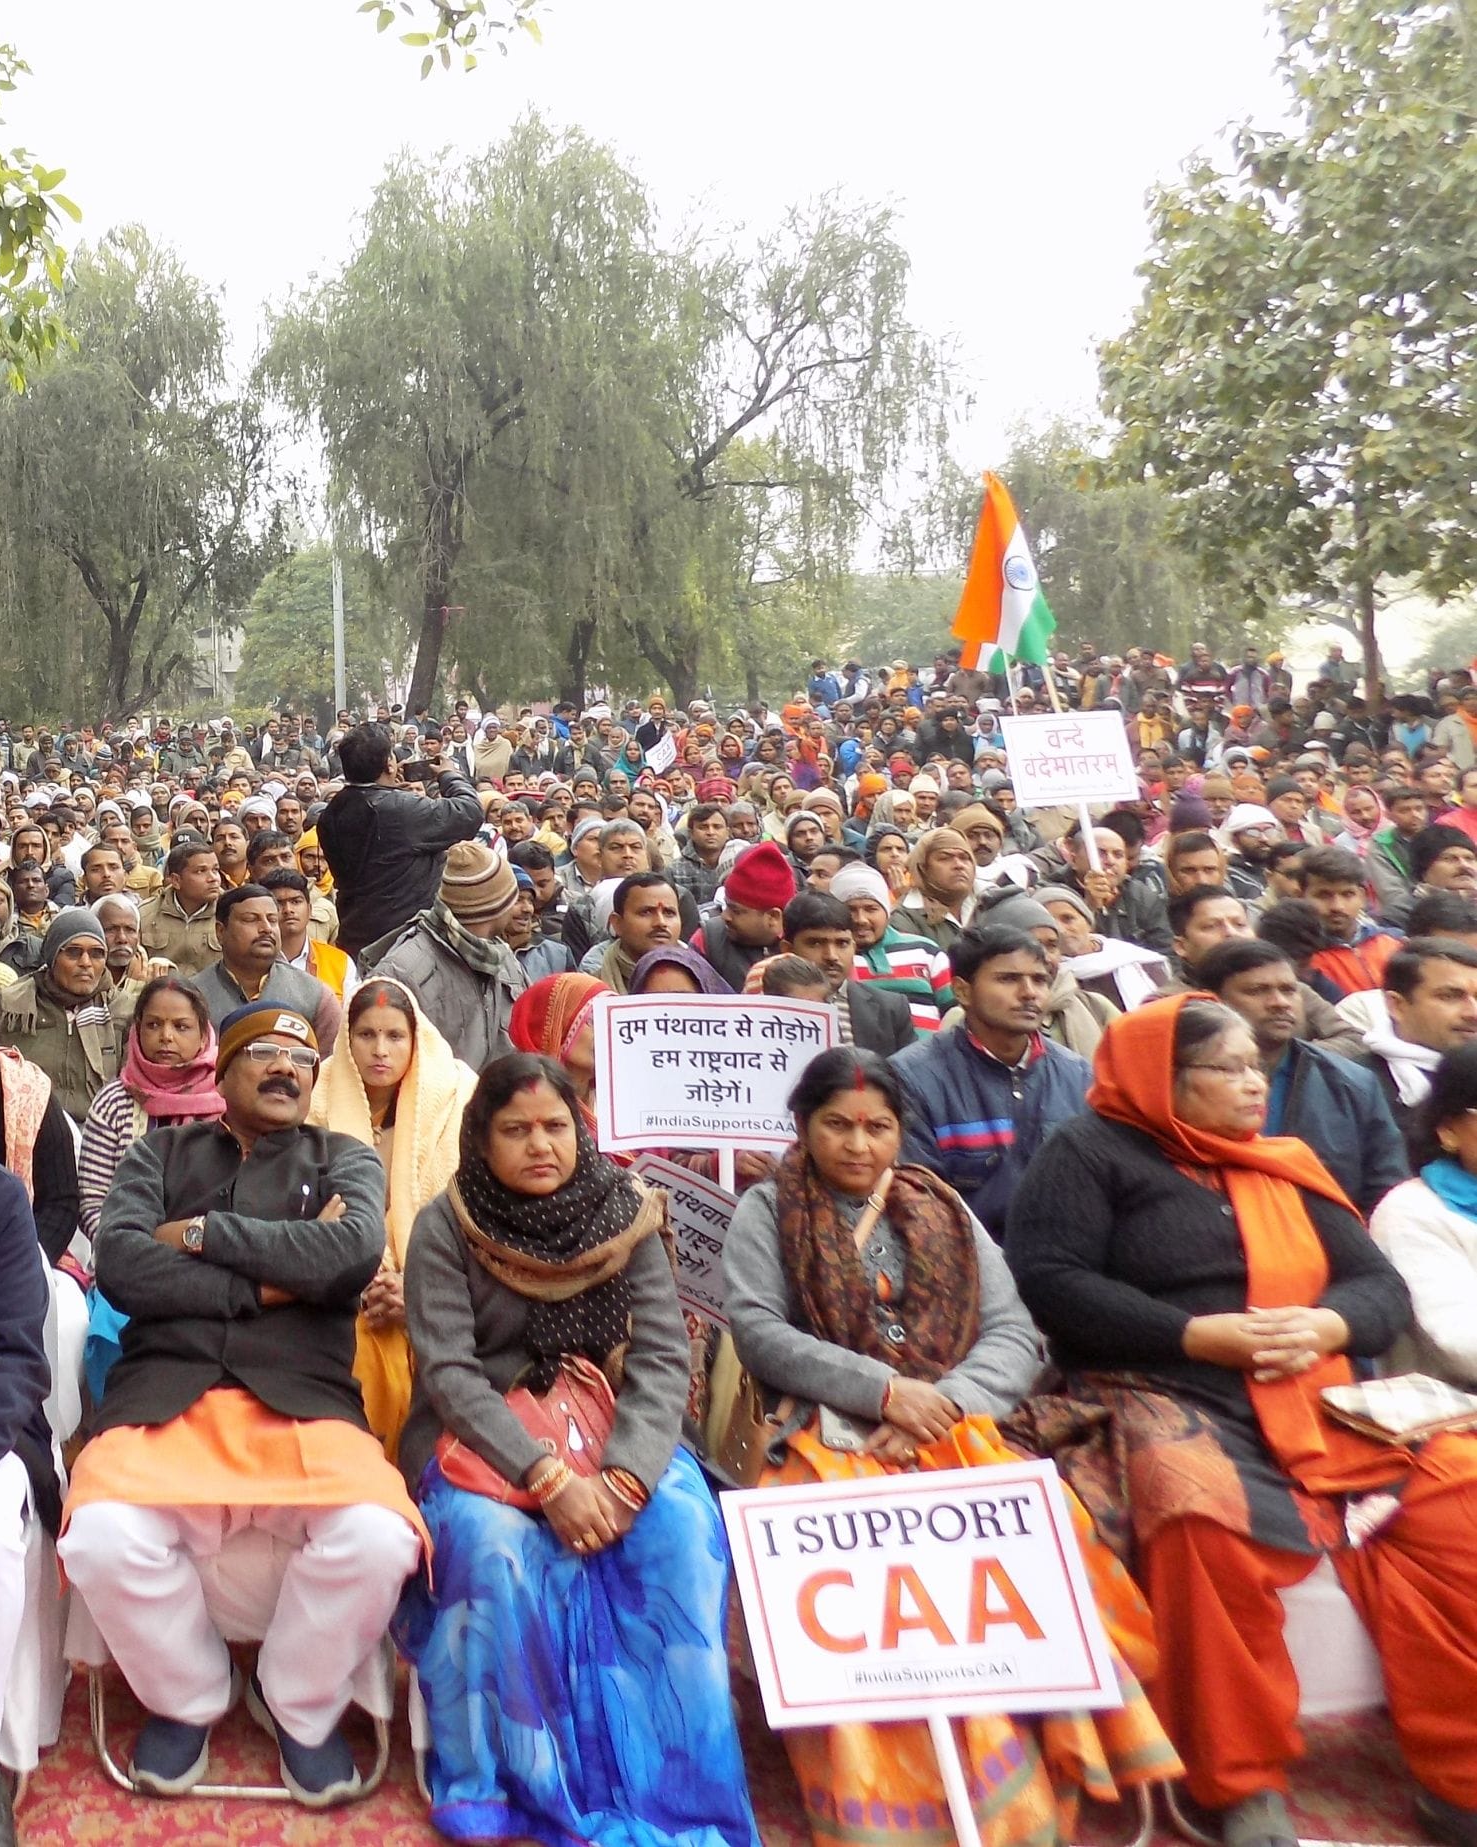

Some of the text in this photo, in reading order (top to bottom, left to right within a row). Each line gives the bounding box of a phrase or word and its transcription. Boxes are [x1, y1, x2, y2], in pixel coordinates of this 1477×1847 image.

[1045, 722, 1085, 749] वन्दे
[1021, 751, 1123, 780] वंदेमातरम्
[617, 1013, 822, 1046] तुम पंथवाद से तोड़ोगे
[650, 1048, 789, 1074] हम राष्ट्रवाद से
[645, 1114, 797, 1135] #IndiaSupportsCAA
[760, 1494, 1032, 1557] I SUPPORT
[796, 1555, 1048, 1655] CAA
[854, 1661, 1013, 1686] #IndiaSupportsCAA
